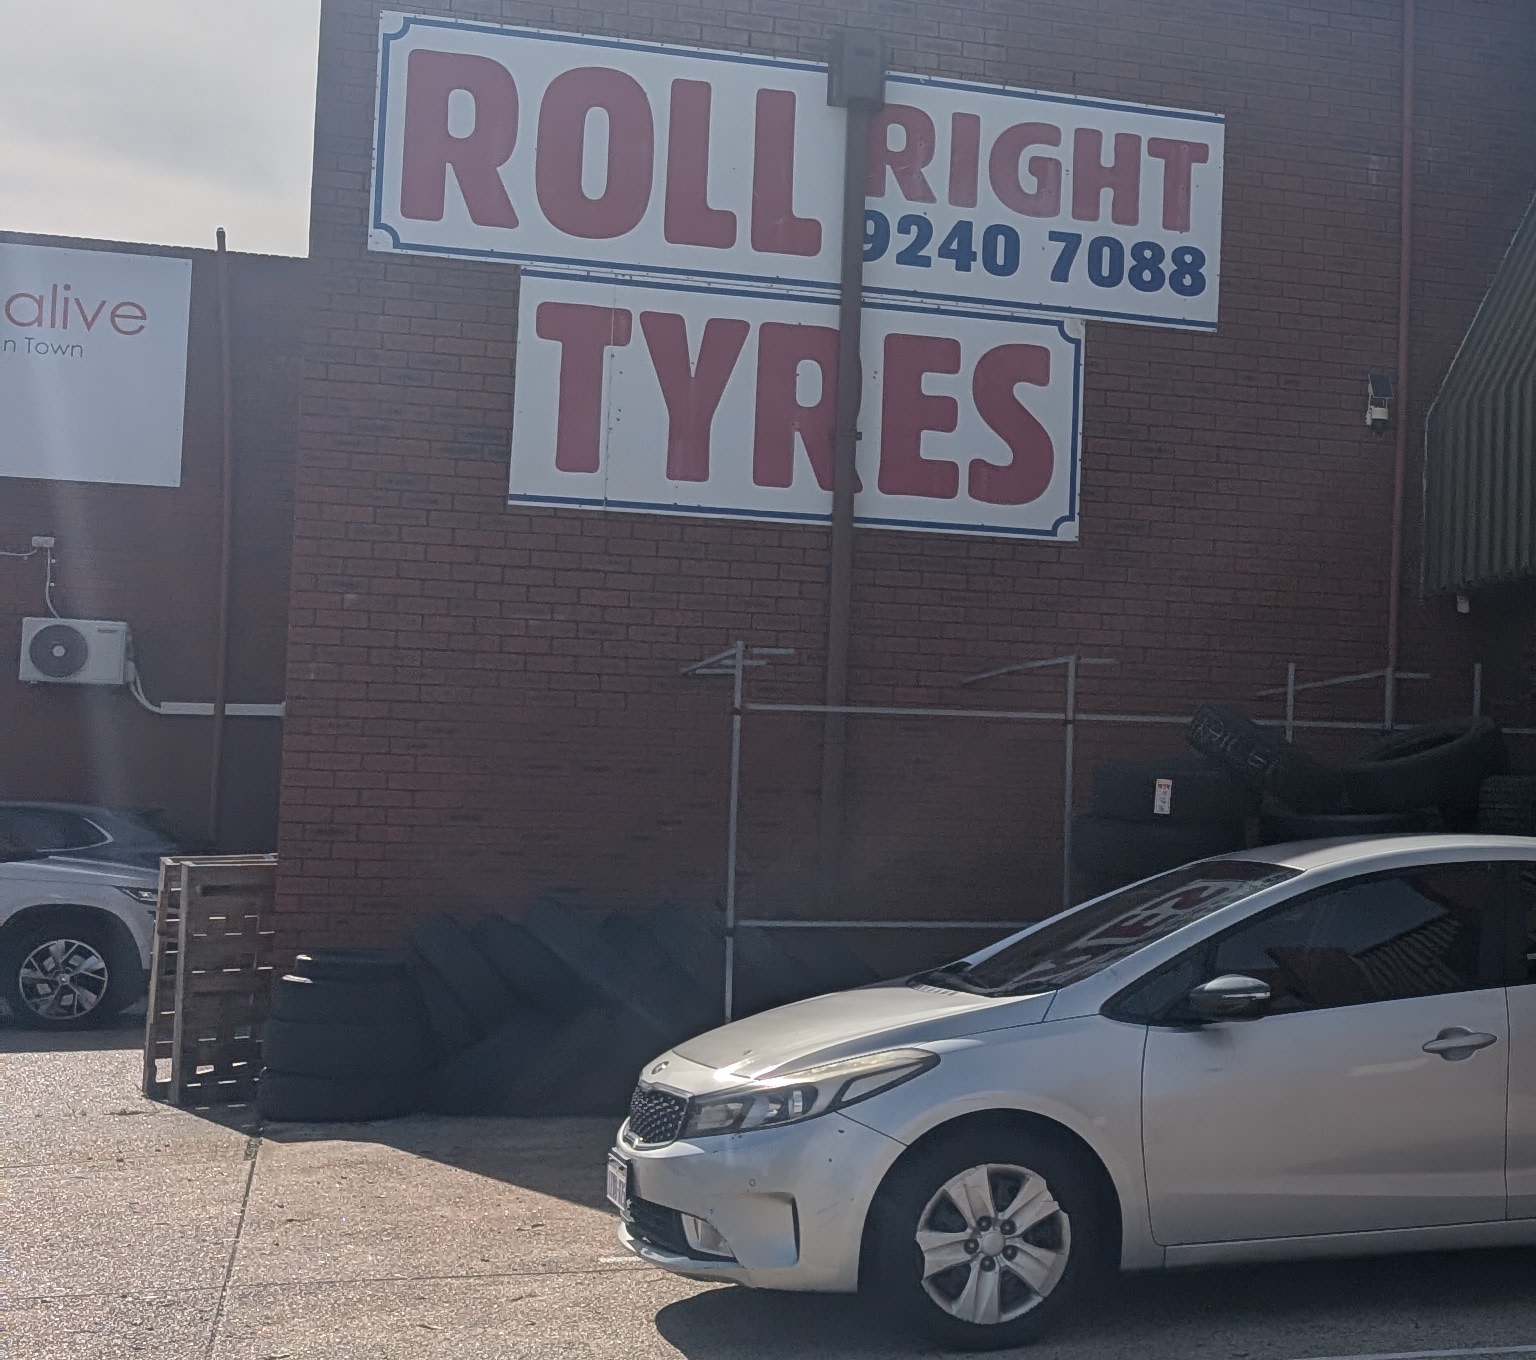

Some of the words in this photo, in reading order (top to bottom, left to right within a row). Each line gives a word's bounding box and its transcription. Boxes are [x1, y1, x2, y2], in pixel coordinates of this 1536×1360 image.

[400, 48, 822, 257] ROLL
[864, 103, 1210, 234] RIGHT
[861, 209, 1021, 277] 9240
[1048, 230, 1208, 297] 7088
[4, 283, 148, 336] alive
[24, 336, 84, 358] Town
[535, 300, 1056, 506] TYRES
